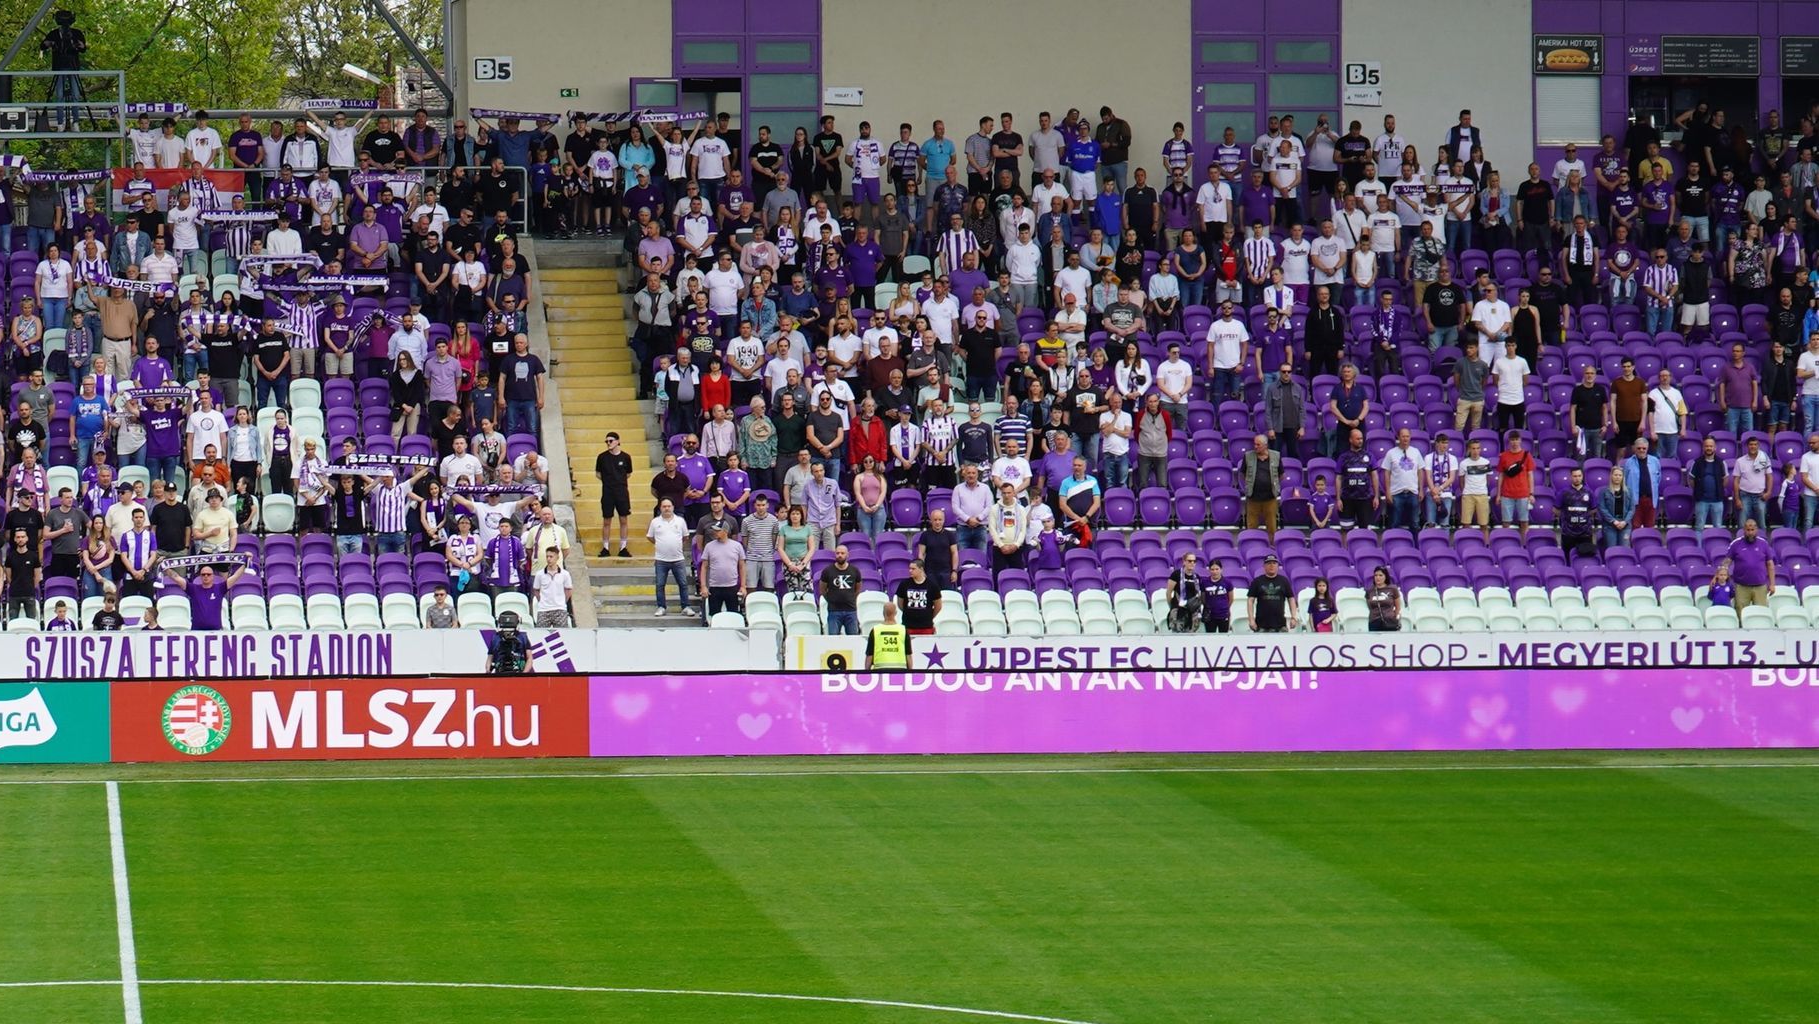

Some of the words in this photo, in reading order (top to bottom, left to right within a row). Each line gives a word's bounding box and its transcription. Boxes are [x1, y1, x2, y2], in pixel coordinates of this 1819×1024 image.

[475, 59, 510, 79] B5
[1346, 64, 1379, 84] B5
[884, 637, 898, 645] 544
[964, 641, 1101, 669] ÚJPEST
[1112, 645, 1154, 669] FC
[1165, 643, 1355, 669] HIVATALOS
[1369, 643, 1468, 667] SHOP
[1499, 641, 1659, 667] MEGYERI
[1671, 633, 1717, 666] ÚT
[1724, 641, 1764, 665] 13.
[26, 635, 136, 679] SZUSZA
[150, 633, 255, 678] FERENC
[271, 632, 392, 677] STADION
[827, 653, 847, 671] 9
[251, 688, 541, 750] MLSZ.hu
